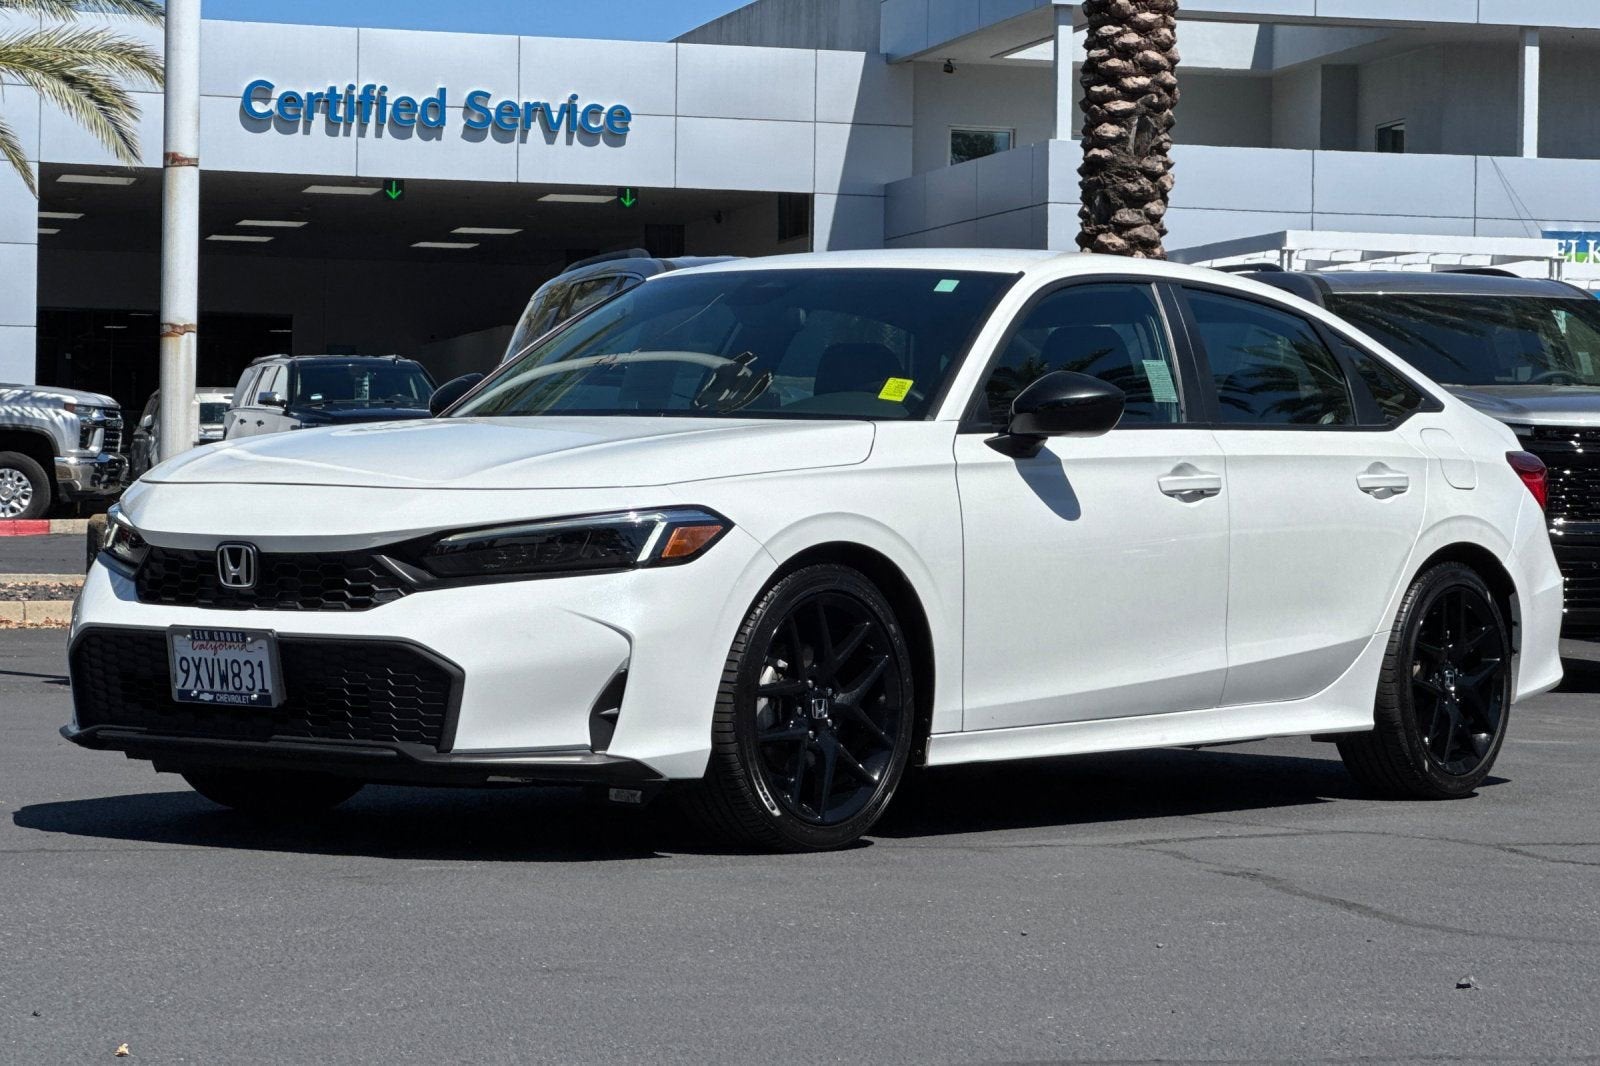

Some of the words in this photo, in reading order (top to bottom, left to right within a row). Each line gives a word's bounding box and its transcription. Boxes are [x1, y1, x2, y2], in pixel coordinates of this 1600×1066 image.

[241, 79, 447, 128] Certified
[464, 90, 632, 135] Service
[193, 630, 209, 640] ELK
[213, 631, 243, 642] GROVE
[179, 656, 269, 692] 9XVW831
[215, 693, 250, 704] CHEVROLET
